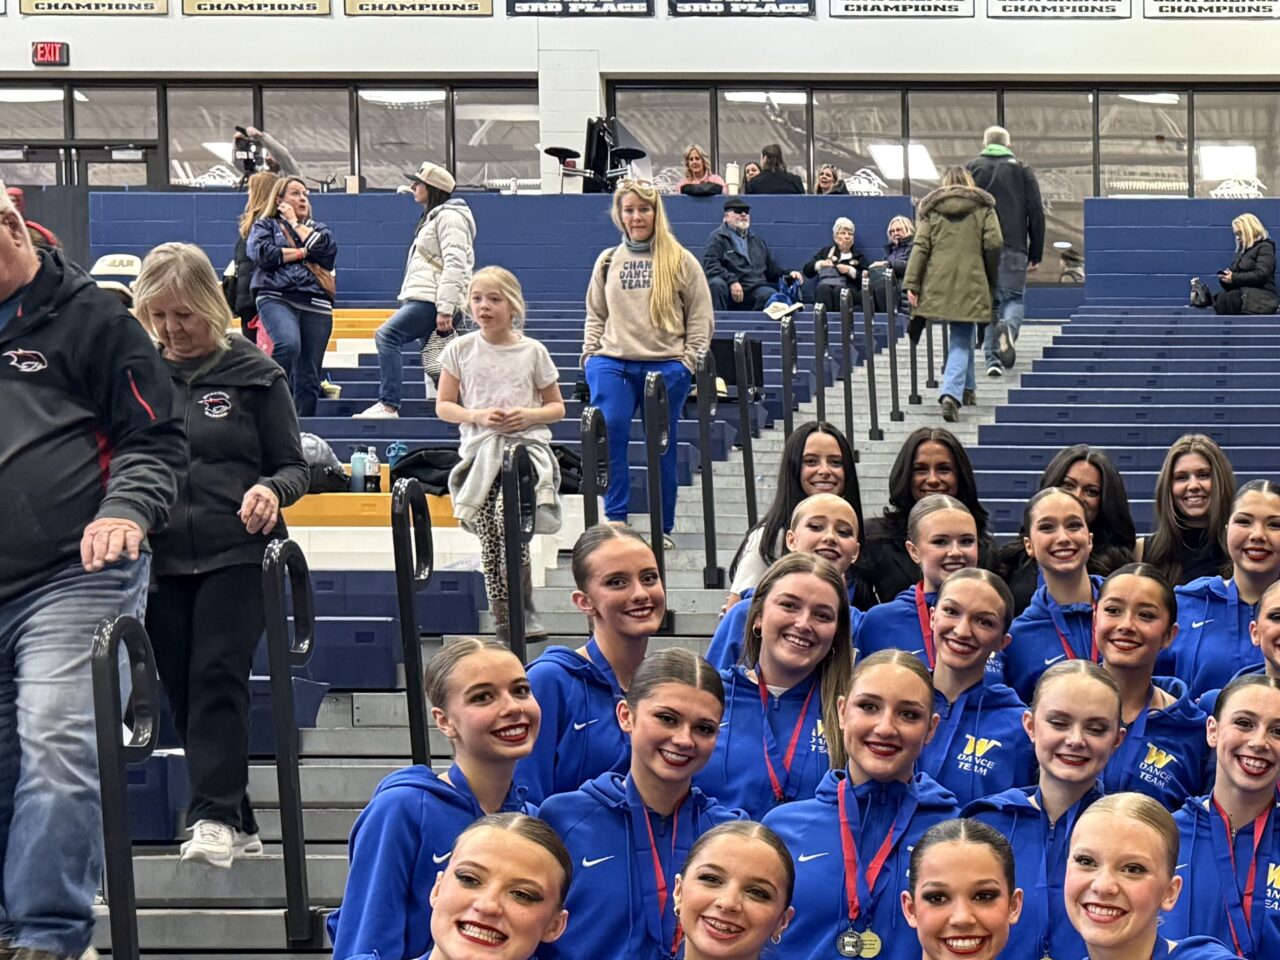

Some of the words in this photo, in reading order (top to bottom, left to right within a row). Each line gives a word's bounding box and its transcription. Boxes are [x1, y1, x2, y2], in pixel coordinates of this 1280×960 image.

[35, 2, 155, 11] CHAMPIONS
[197, 3, 317, 11] CHAMPIONS
[358, 3, 479, 11] CHAMPIONS
[514, 2, 563, 12] 3RD
[569, 2, 647, 12] PLACE
[676, 2, 724, 12] 3RD
[730, 2, 809, 12] PLACE
[844, 4, 959, 12] CHAMPIONS
[1001, 5, 1117, 13] CHAMPIONS
[1158, 5, 1273, 13] CHAMPIONS
[37, 43, 61, 61] EXIT
[621, 279, 650, 290] TEAM
[1144, 742, 1180, 769] W
[957, 753, 996, 769] DANCE
[1139, 761, 1173, 783] DANCE
[1140, 771, 1165, 789] TEAM
